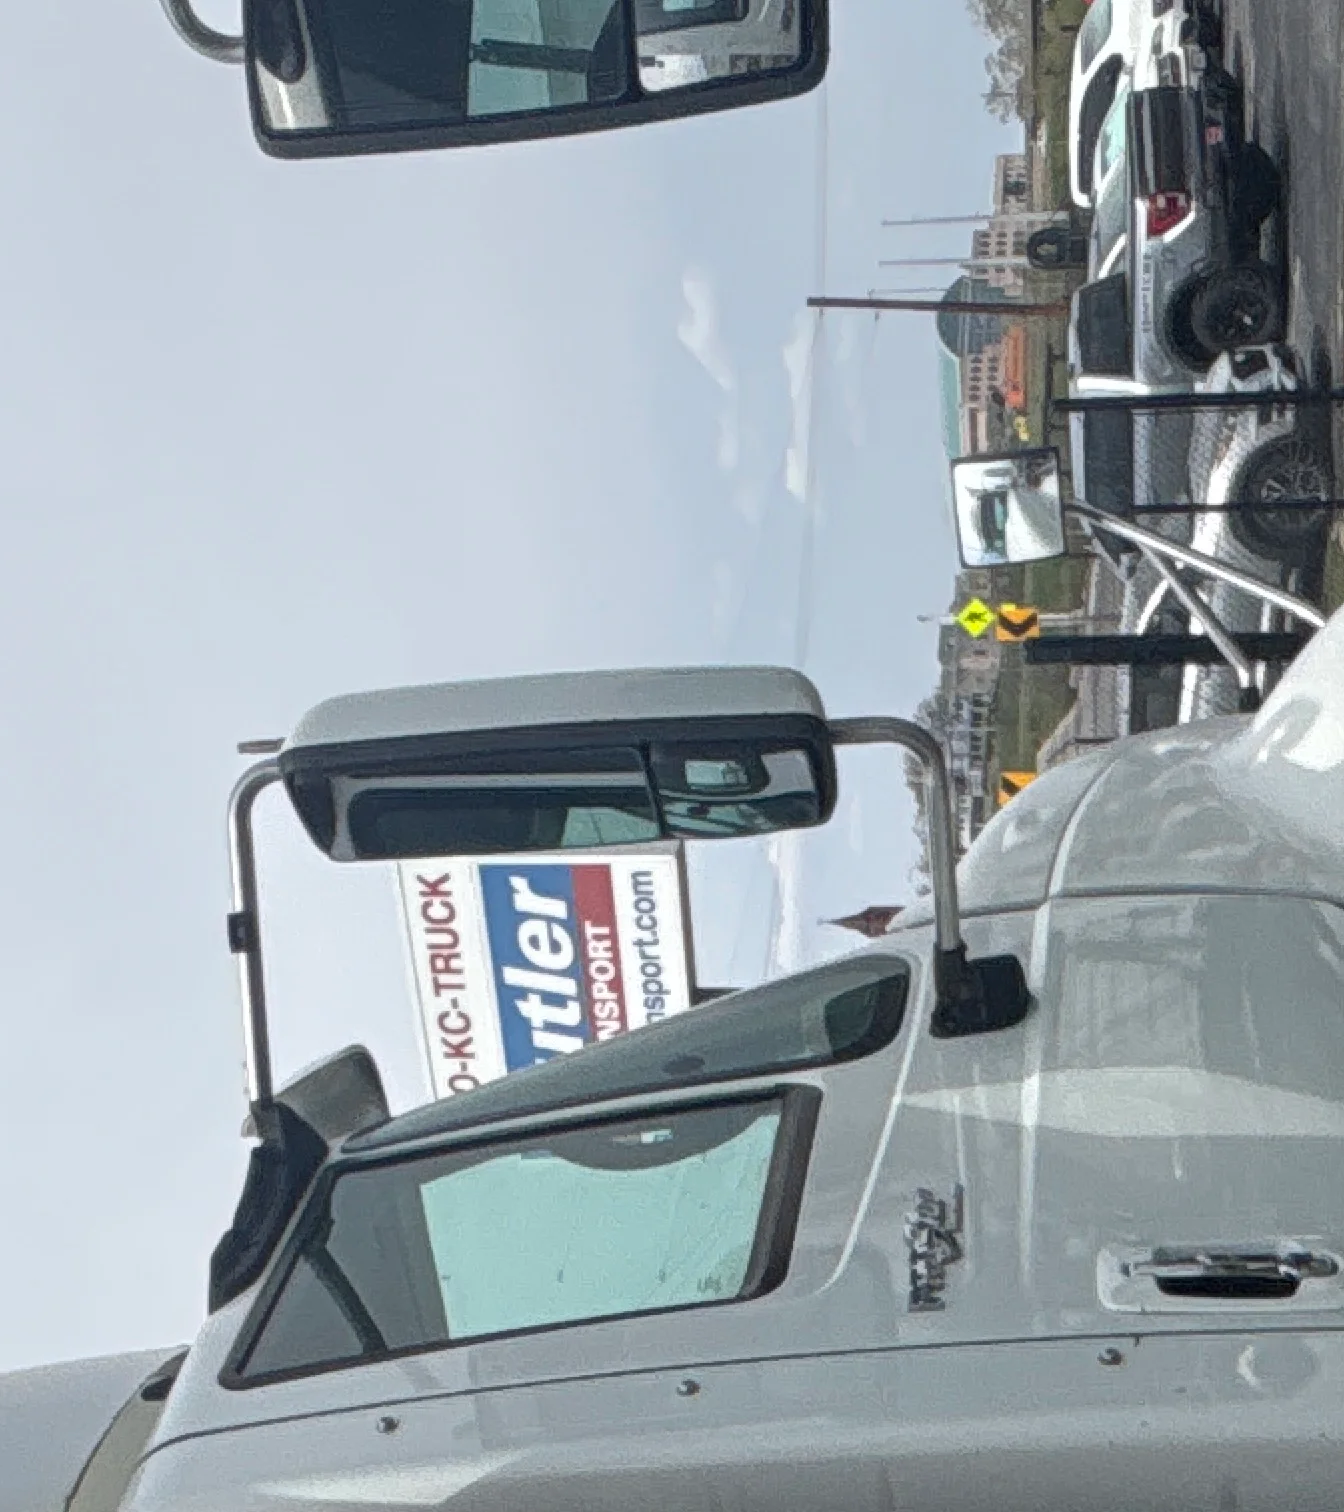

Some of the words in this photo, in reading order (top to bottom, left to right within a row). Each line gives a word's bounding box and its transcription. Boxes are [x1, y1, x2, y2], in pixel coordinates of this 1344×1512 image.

[416, 872, 480, 1093] 0-KC-TRUCK
[503, 874, 585, 1064] utler
[585, 920, 622, 1042] NSPORT
[631, 870, 672, 1024] nsport.com
